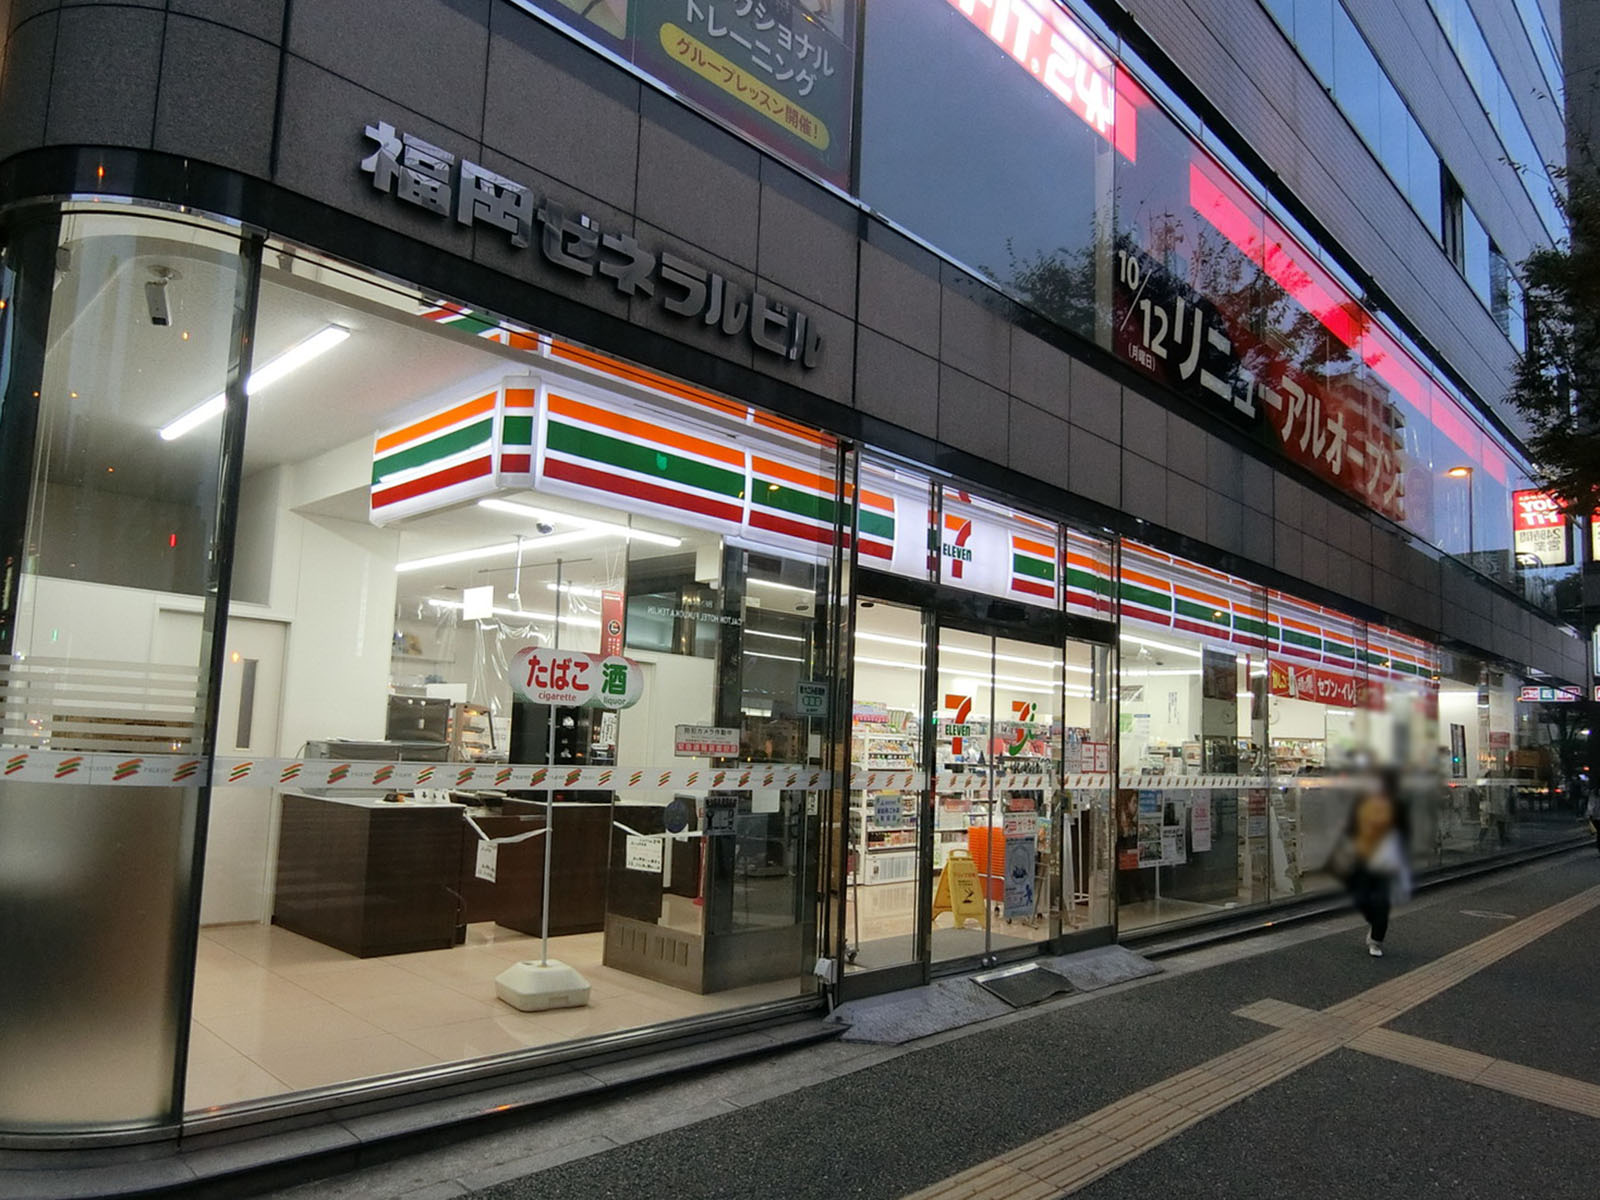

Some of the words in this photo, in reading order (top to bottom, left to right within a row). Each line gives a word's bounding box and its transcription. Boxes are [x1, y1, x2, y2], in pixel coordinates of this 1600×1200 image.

[687, 0, 817, 96] トレーニング
[361, 120, 825, 369] 福岡ゼネラルビル
[526, 655, 590, 691] たばこ
[601, 662, 628, 695] 酒
[538, 690, 577, 702] cigarette
[603, 696, 626, 708] liquor
